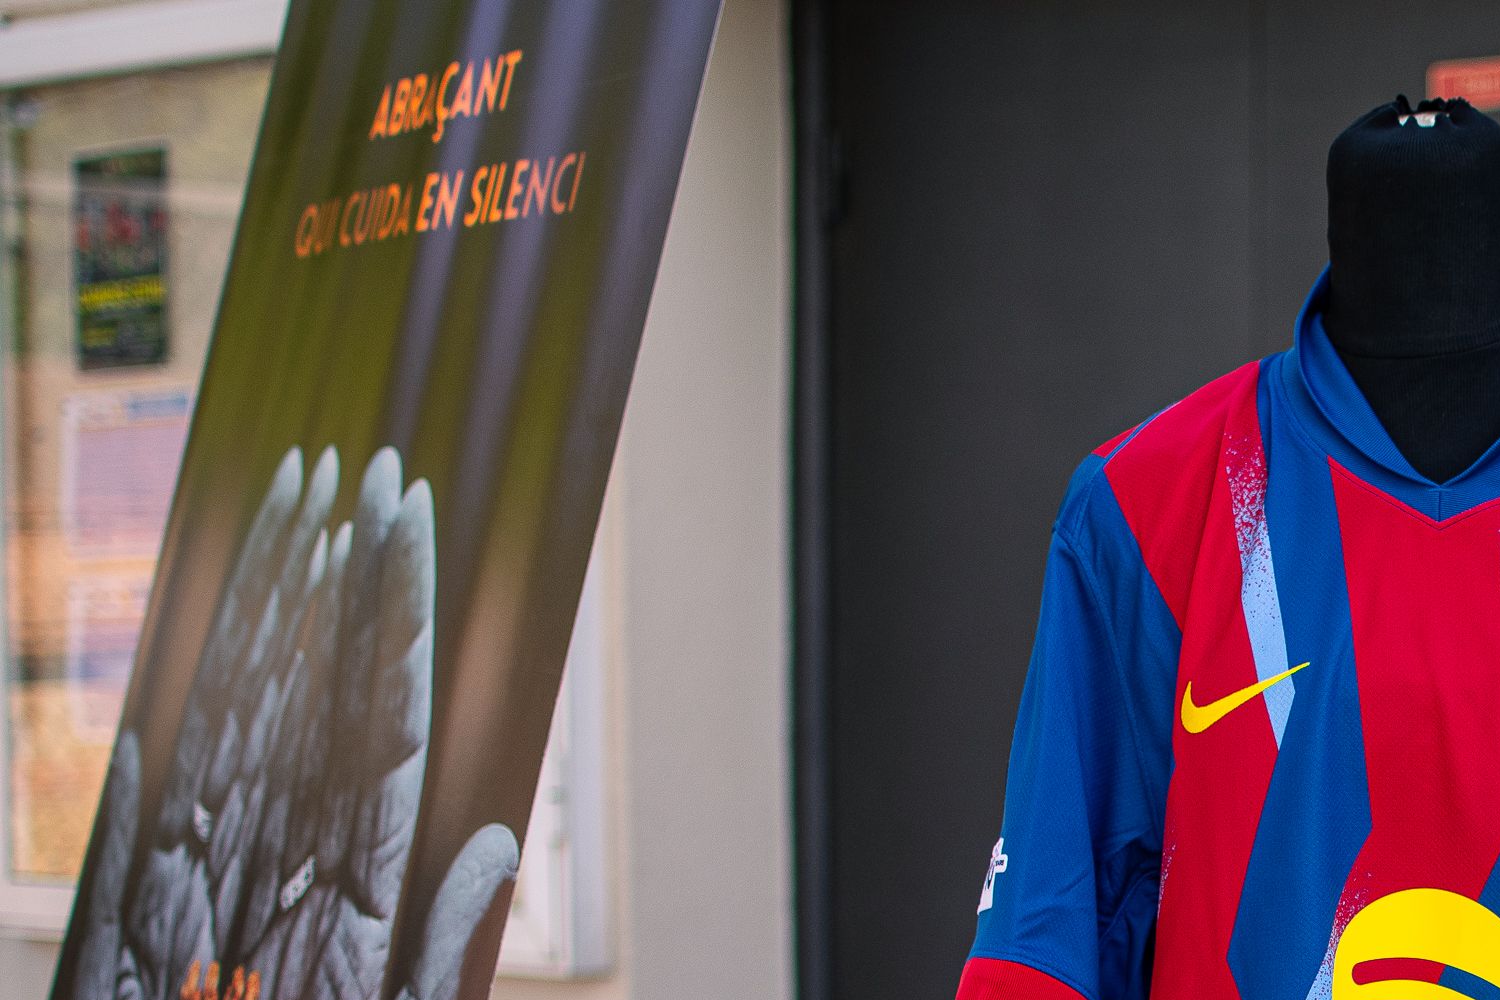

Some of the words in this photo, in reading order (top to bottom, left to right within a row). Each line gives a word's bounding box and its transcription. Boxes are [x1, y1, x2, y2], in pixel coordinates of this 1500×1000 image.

[369, 49, 523, 143] ABRAÇANT
[415, 168, 464, 232] EN
[463, 151, 587, 228] SILENCI
